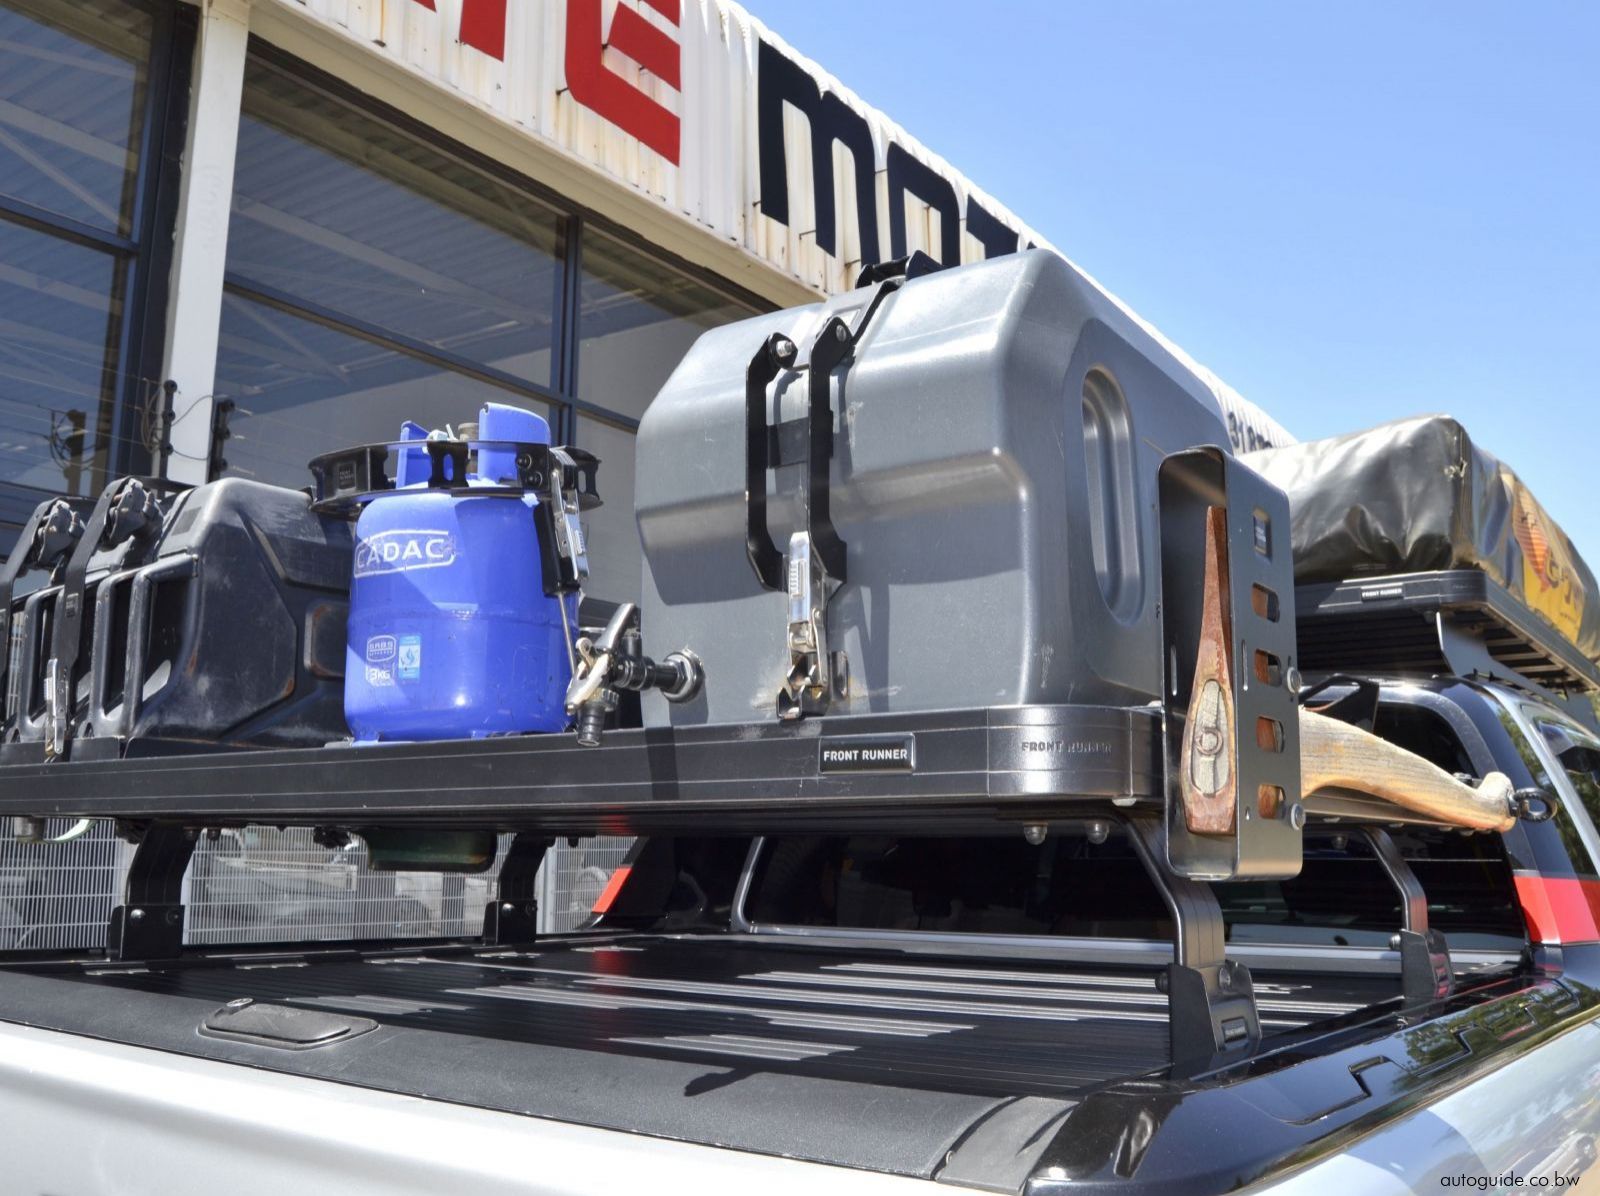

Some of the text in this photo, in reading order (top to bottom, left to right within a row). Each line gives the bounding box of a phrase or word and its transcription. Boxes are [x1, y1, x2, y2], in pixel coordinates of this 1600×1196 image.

[357, 538, 445, 568] CADAC
[1021, 740, 1064, 752] FRONT
[823, 748, 908, 762] FRONT RUNNER
